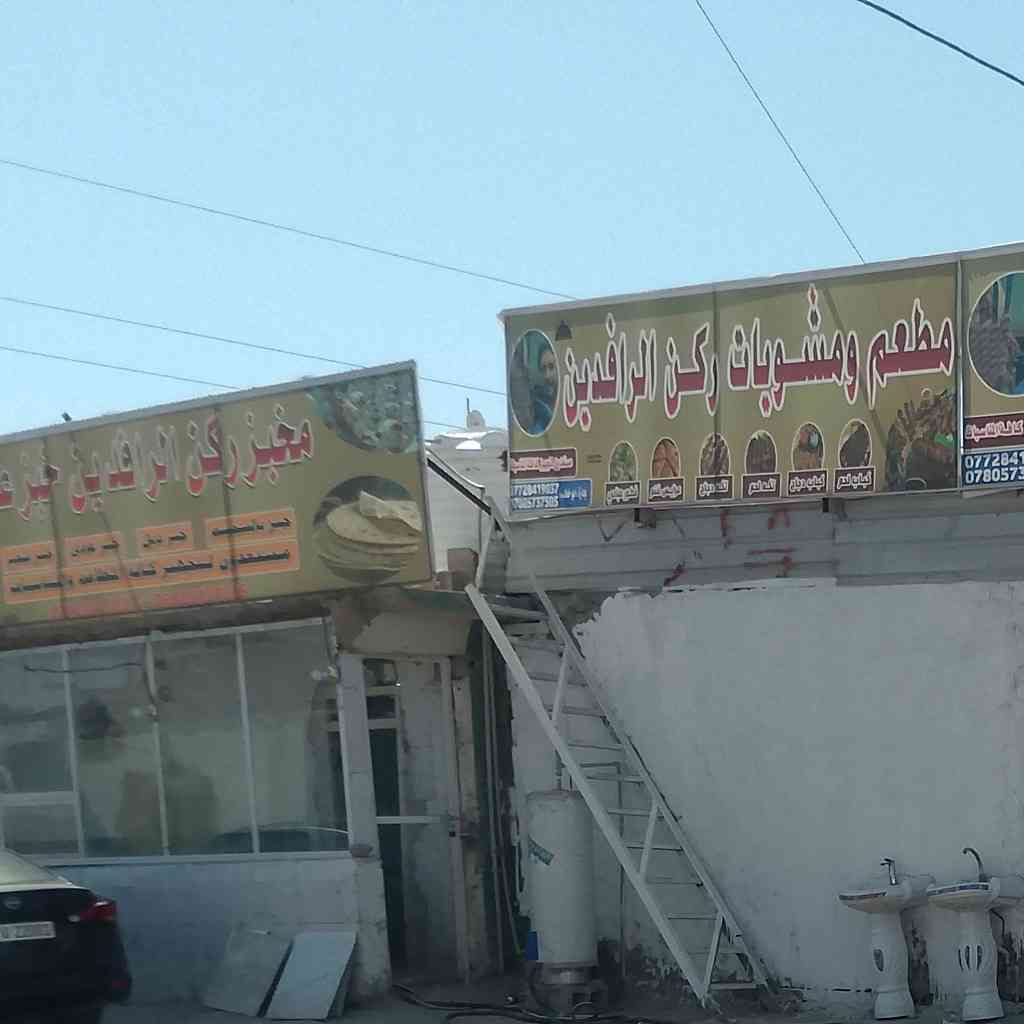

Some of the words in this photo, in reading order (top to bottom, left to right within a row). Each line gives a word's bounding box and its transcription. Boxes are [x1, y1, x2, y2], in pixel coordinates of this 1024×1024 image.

[563, 312, 657, 432] الرافدين
[663, 322, 719, 420] ركن
[727, 283, 860, 419] ومشويات
[867, 297, 955, 410] مطعم
